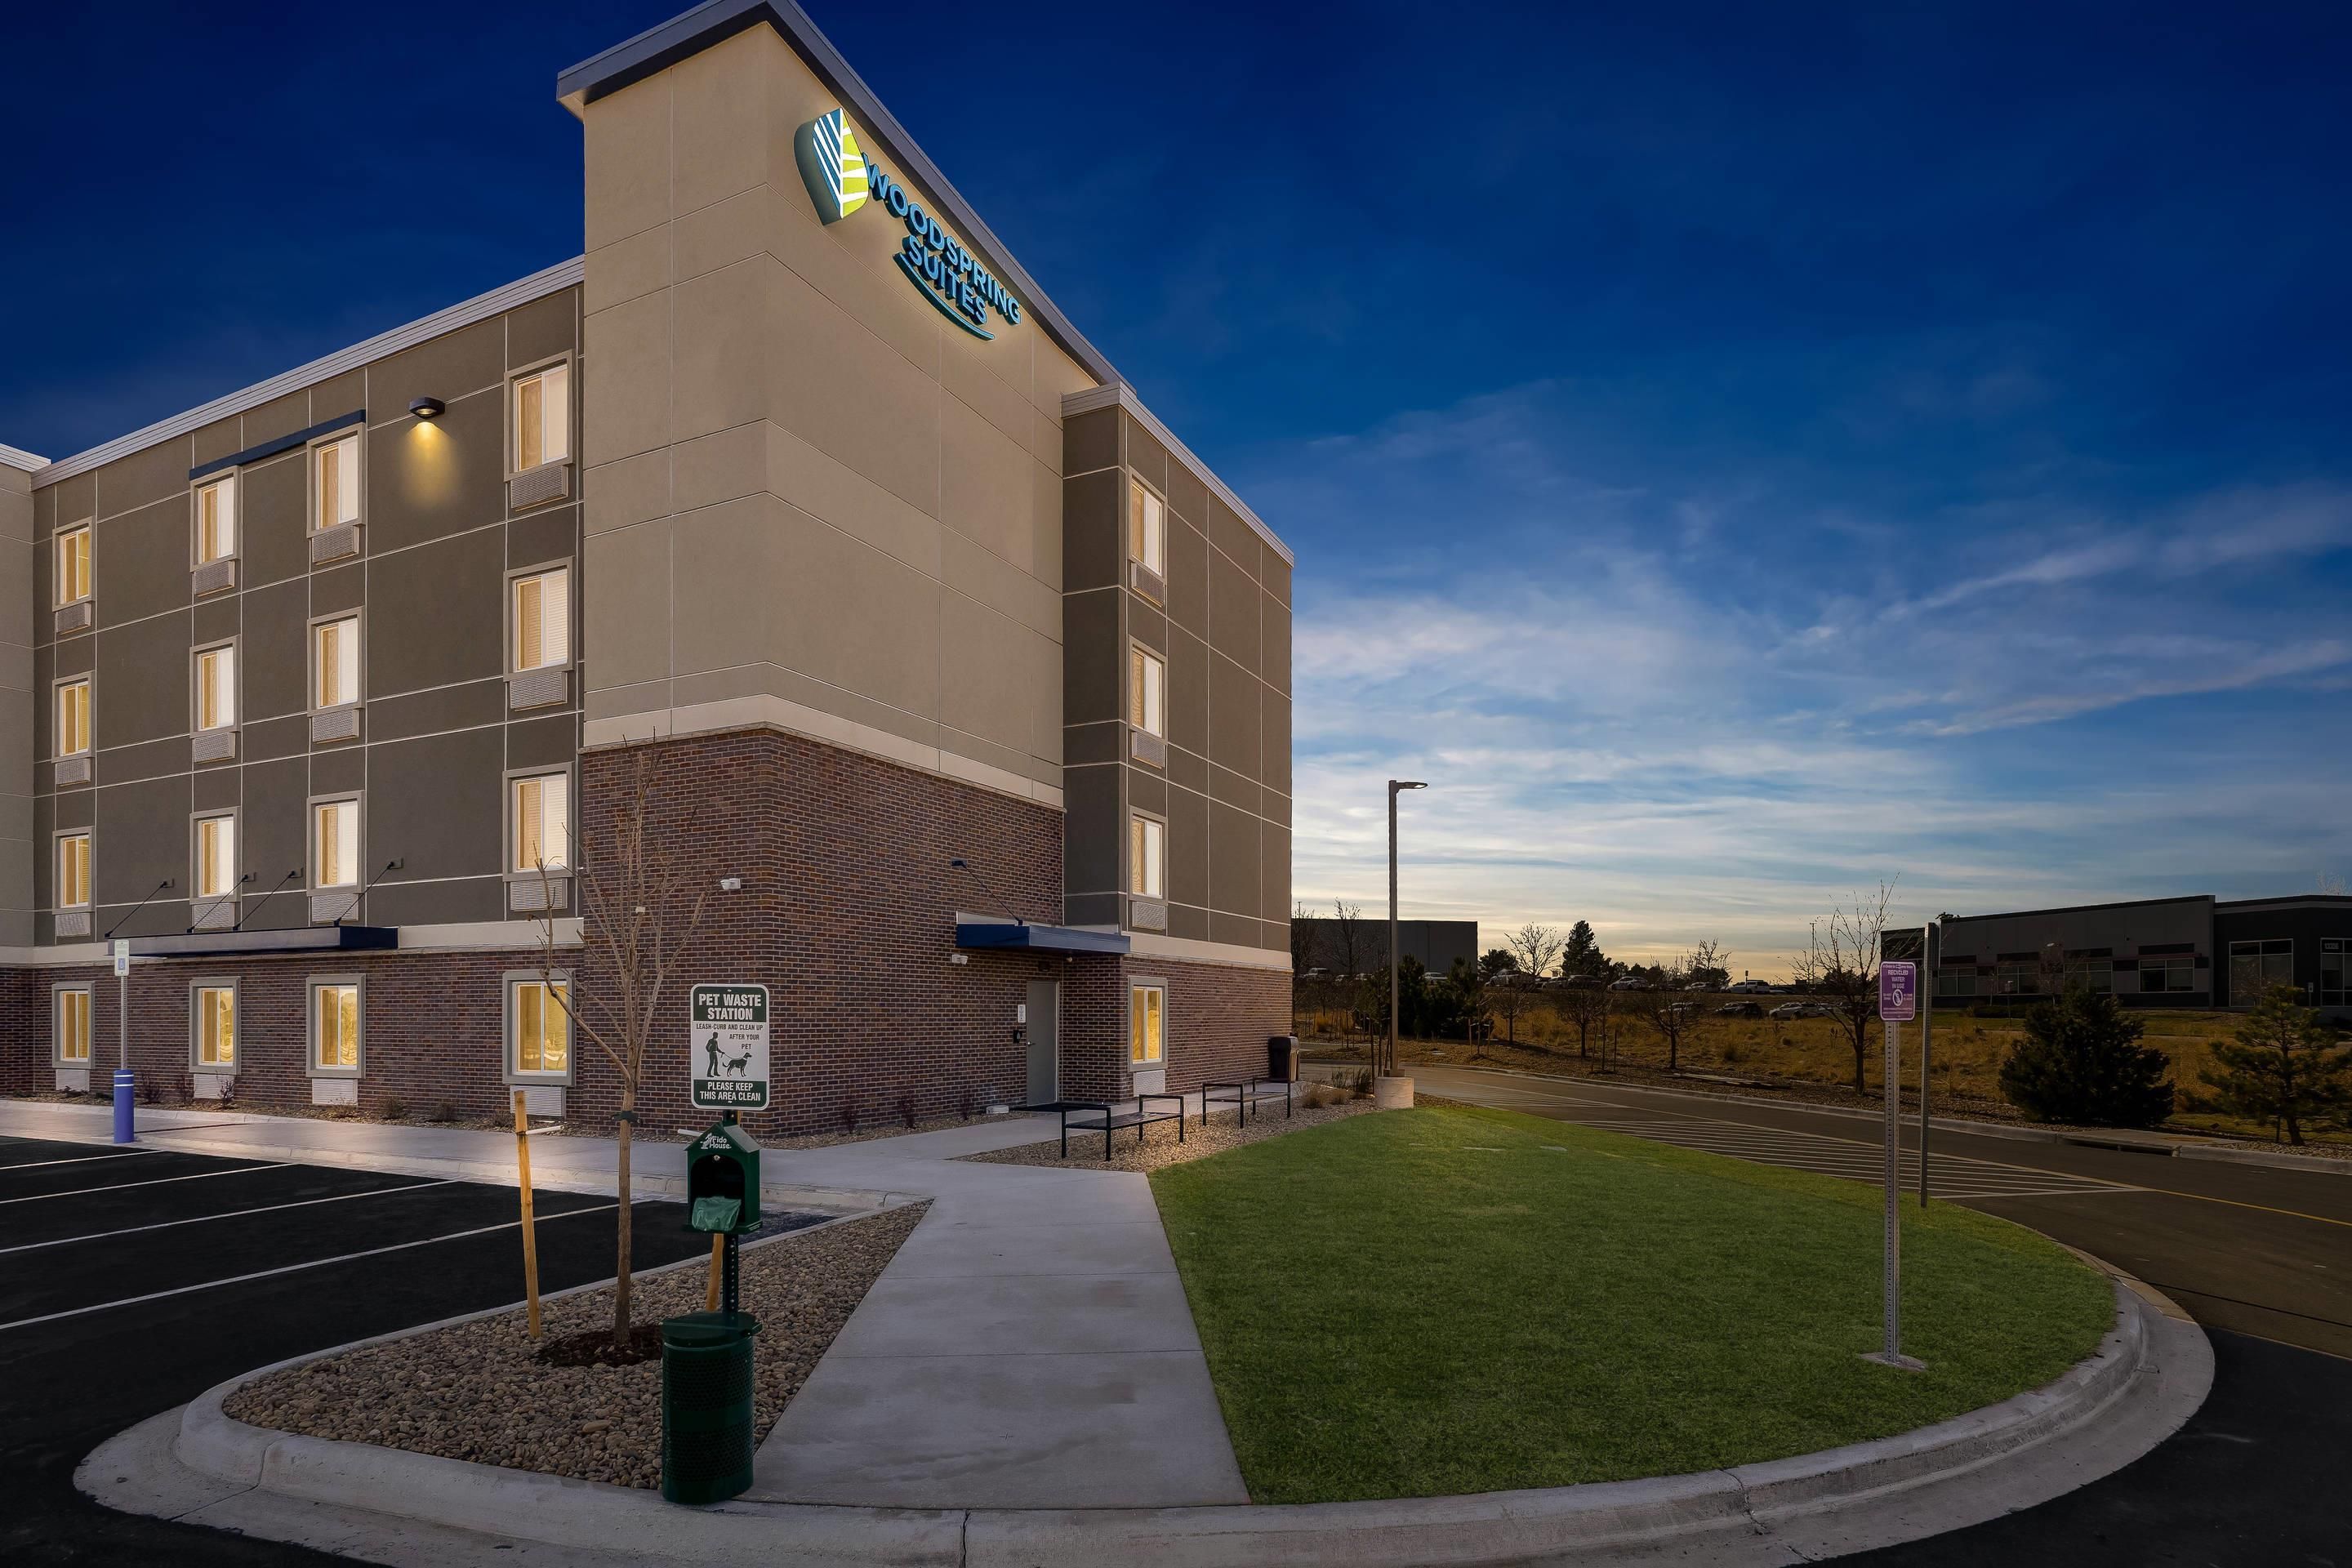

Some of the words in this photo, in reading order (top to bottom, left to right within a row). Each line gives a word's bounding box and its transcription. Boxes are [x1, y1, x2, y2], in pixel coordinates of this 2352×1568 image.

[862, 152, 1021, 325] WOODSPRING
[902, 235, 987, 325] SUITES
[698, 993, 720, 1006] PET
[723, 994, 761, 1007] WASTE
[707, 1008, 753, 1020] STATION
[707, 1081, 733, 1091] PLEASE
[735, 1082, 753, 1092] KEEP
[700, 1091, 716, 1099] THIS
[718, 1091, 737, 1101] AREA
[738, 1092, 760, 1101] CLEAN
